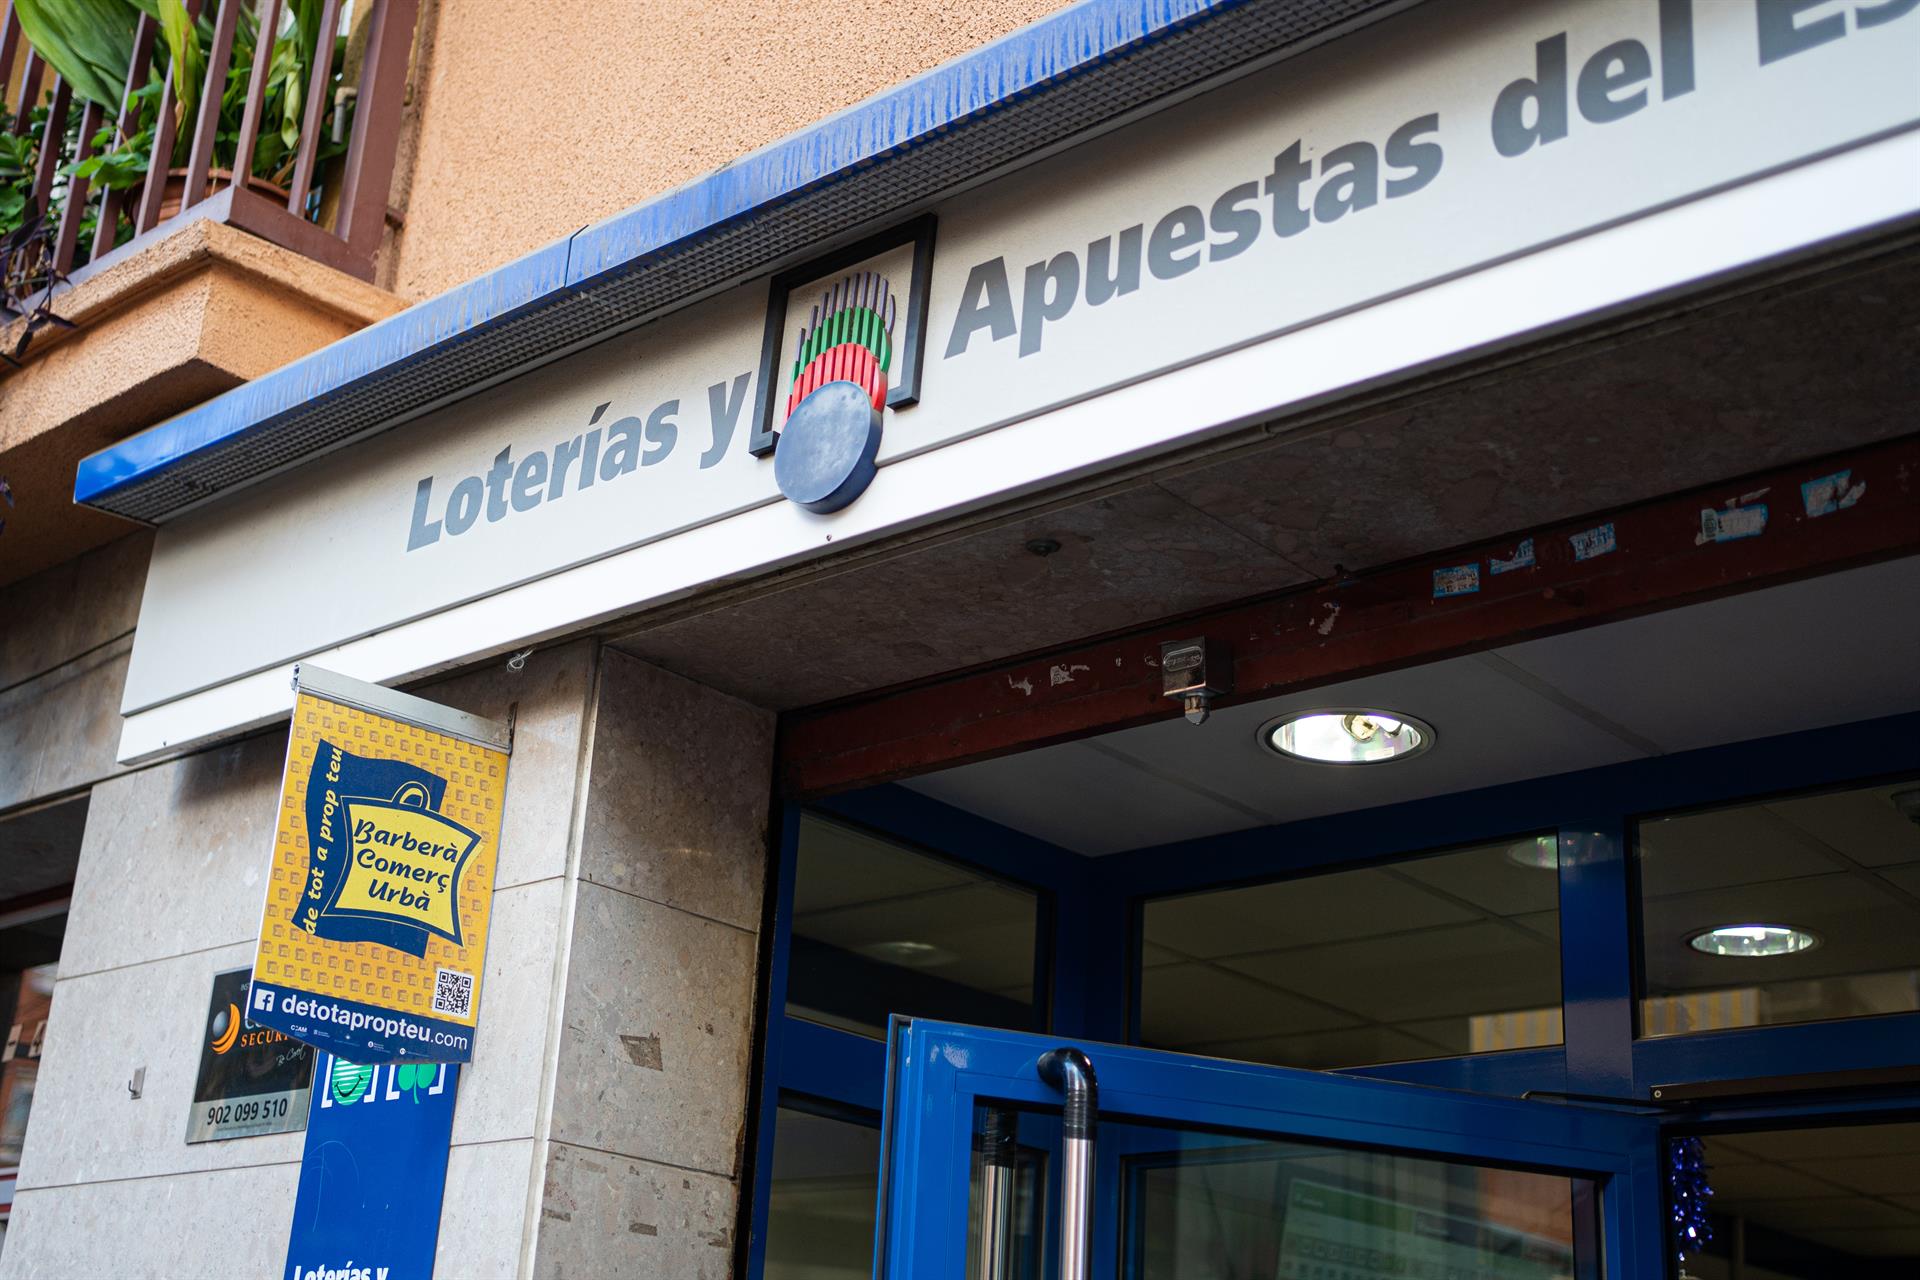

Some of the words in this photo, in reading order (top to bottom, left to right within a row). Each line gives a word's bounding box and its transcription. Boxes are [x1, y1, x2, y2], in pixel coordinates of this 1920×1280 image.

[406, 400, 681, 553] Loterías
[700, 371, 753, 470] y
[943, 112, 1445, 360] Apuestas
[1491, 0, 1696, 158] del
[326, 747, 343, 783] teu
[320, 789, 340, 843] prop
[316, 846, 328, 862] a
[353, 819, 459, 863] Barberà
[308, 867, 325, 901] tot
[357, 848, 450, 893] Comerç
[368, 879, 431, 911] Urbà
[303, 907, 319, 935] de
[241, 1030, 289, 1047] SECUR
[281, 994, 468, 1050] detotapropteu.com
[207, 1105, 232, 1126] 902
[234, 1102, 259, 1122] 099
[262, 1098, 288, 1119] 510
